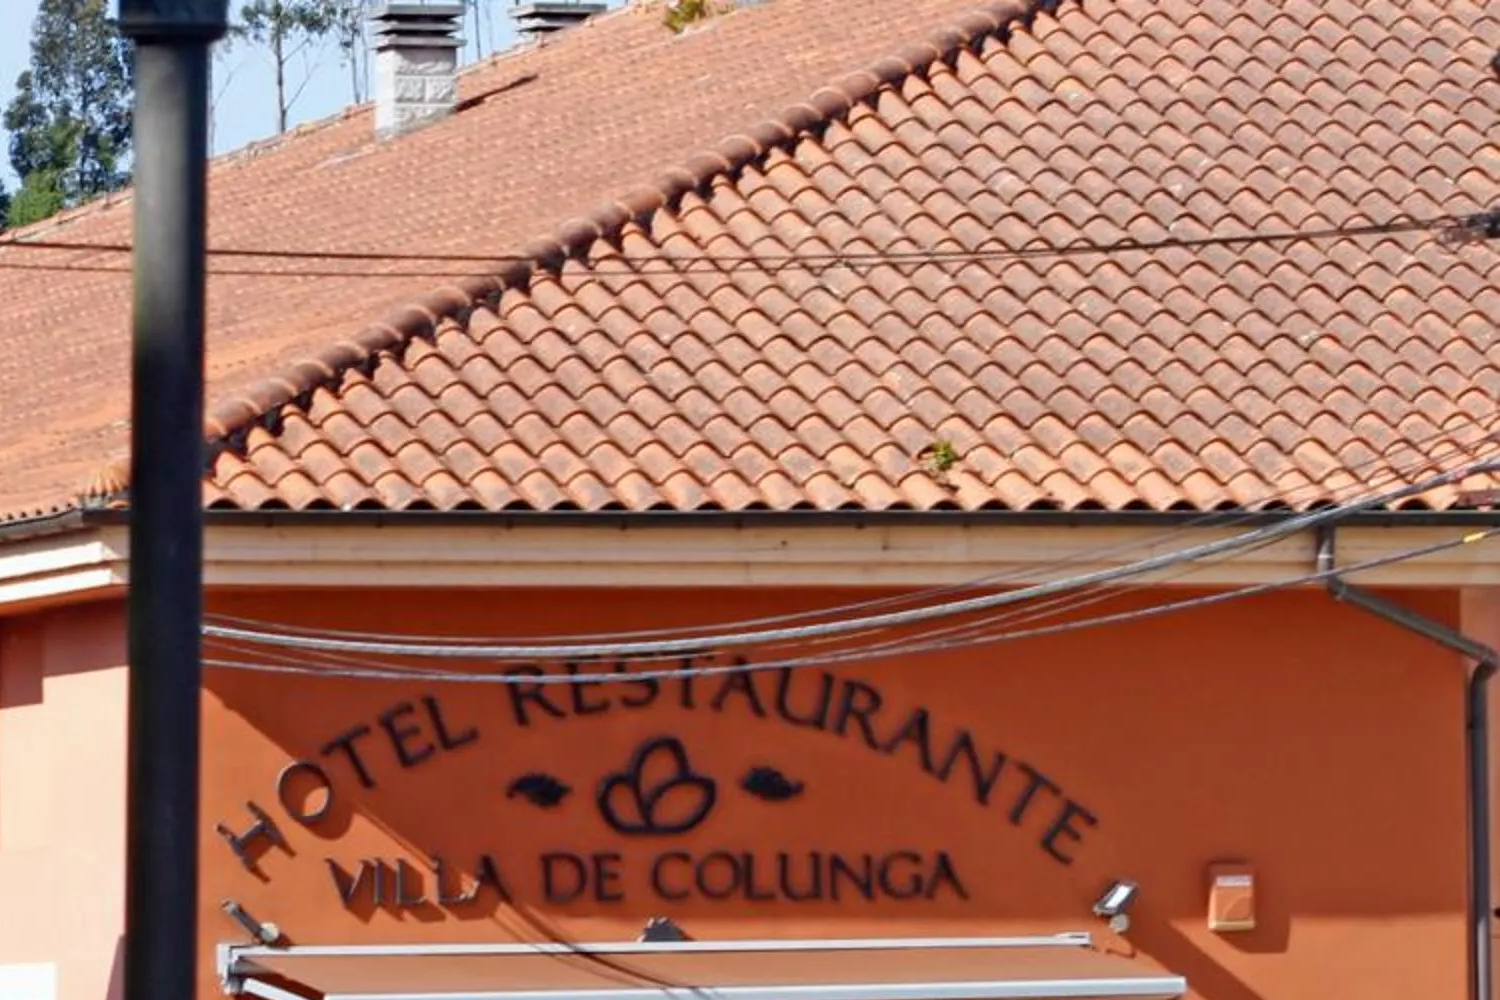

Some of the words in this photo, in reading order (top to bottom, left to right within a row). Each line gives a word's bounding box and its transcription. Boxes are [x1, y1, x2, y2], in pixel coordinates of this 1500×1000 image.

[214, 694, 480, 884] HOTEL
[502, 653, 1100, 866] RESTAURANTE
[325, 853, 513, 905] VILLA
[541, 851, 627, 903] DE
[649, 849, 971, 903] COLUNGA
